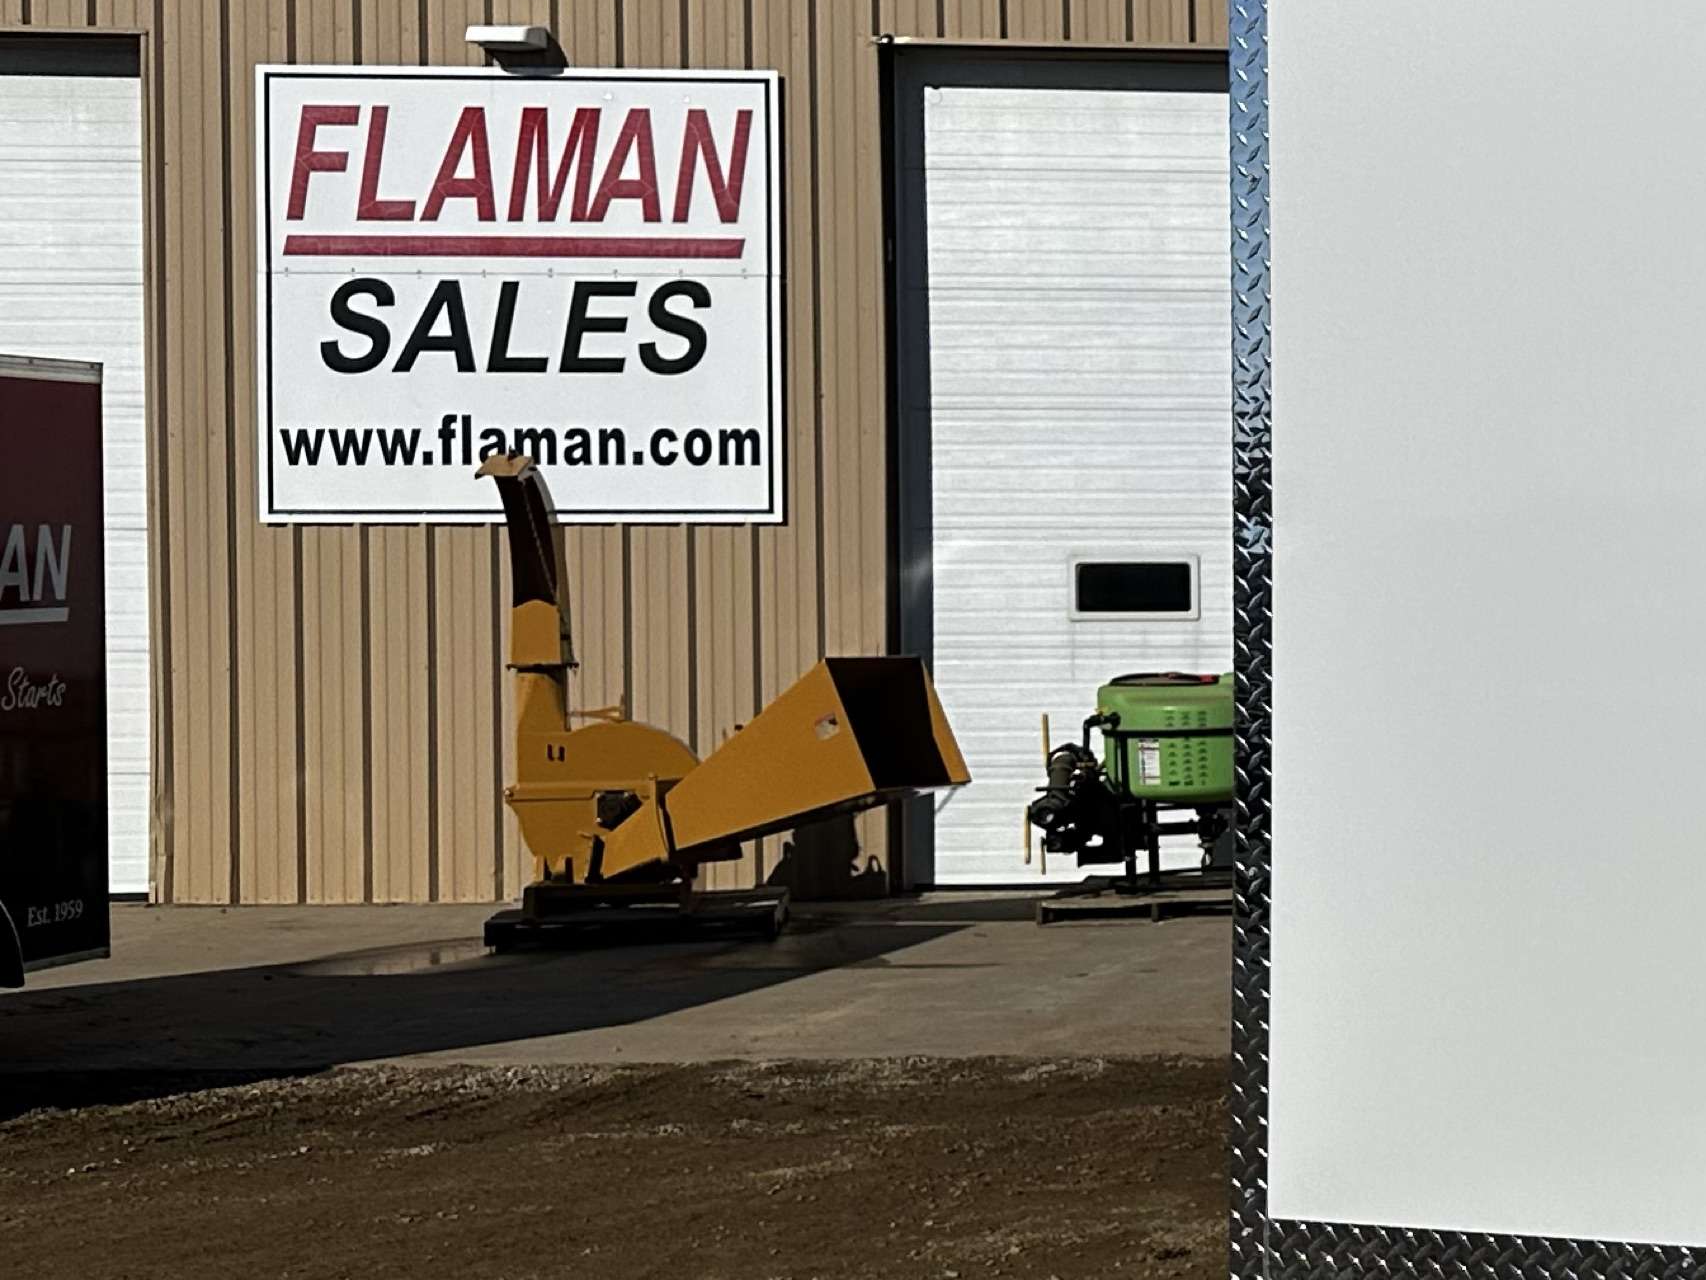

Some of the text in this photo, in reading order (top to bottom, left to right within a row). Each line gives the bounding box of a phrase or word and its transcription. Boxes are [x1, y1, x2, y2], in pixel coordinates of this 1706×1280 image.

[286, 104, 753, 224] FLAMAN
[320, 277, 713, 375] SALES
[280, 414, 762, 467] www.flaman.com
[1, 666, 67, 712] Starts
[55, 899, 84, 923] 1959
